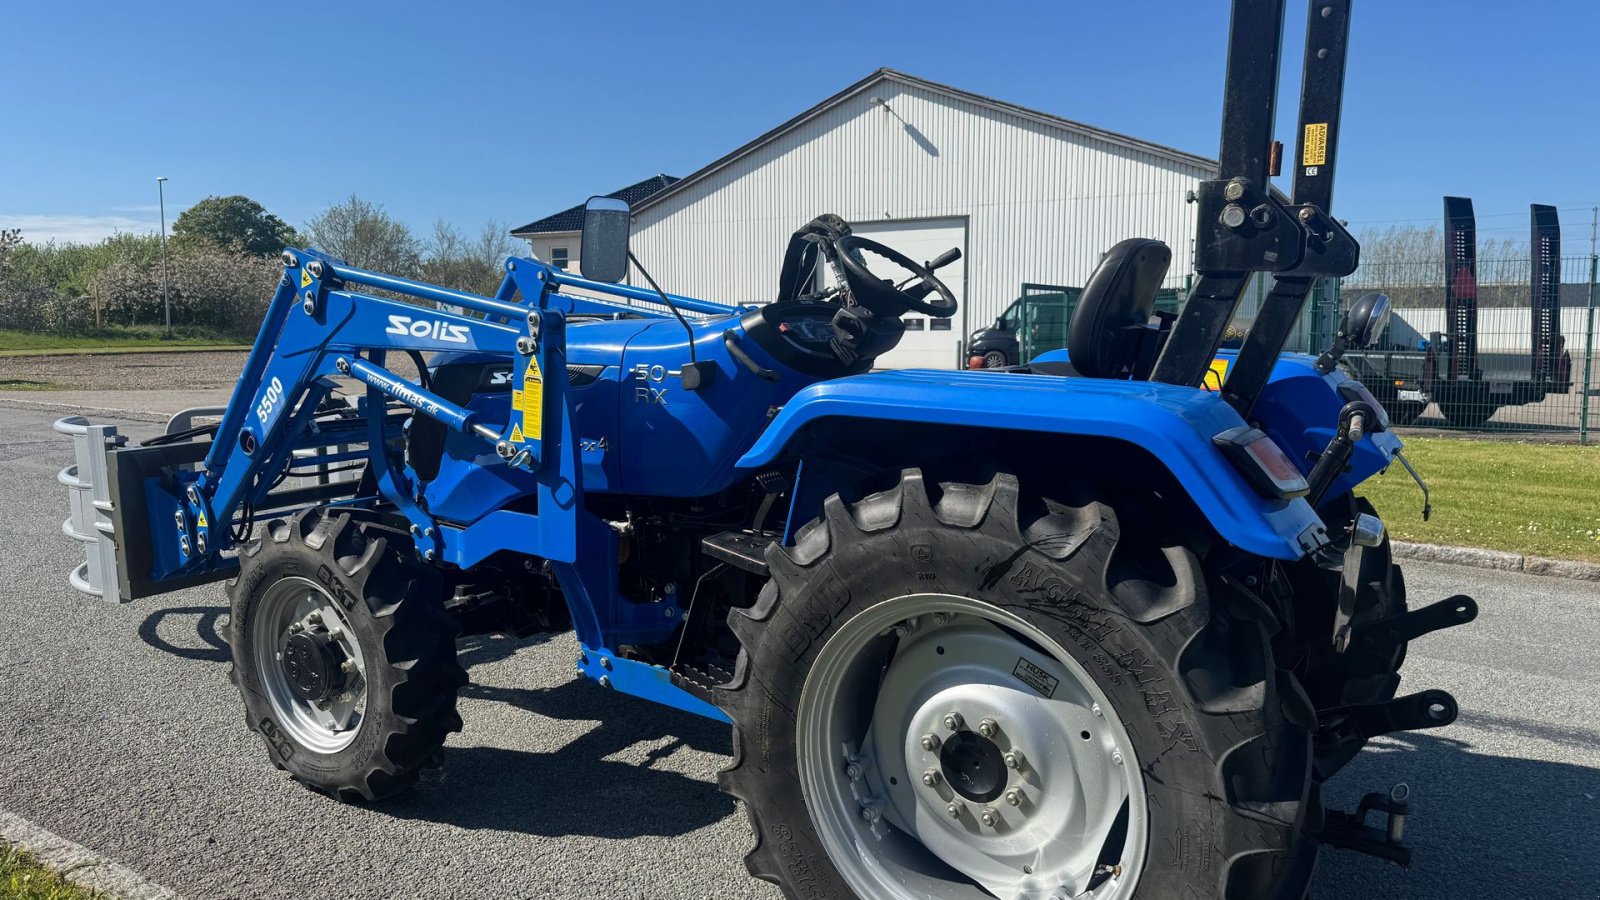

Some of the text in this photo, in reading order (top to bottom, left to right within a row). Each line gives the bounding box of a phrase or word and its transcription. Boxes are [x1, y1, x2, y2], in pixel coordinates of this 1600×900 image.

[1317, 125, 1326, 163] ADVARSEL
[635, 364, 667, 383] 50
[256, 376, 284, 425] 5500
[635, 387, 669, 406] RX
[580, 436, 609, 453] x4
[318, 564, 358, 610] BKT
[1026, 663, 1050, 681] HUSK
[259, 717, 295, 762] BKT
